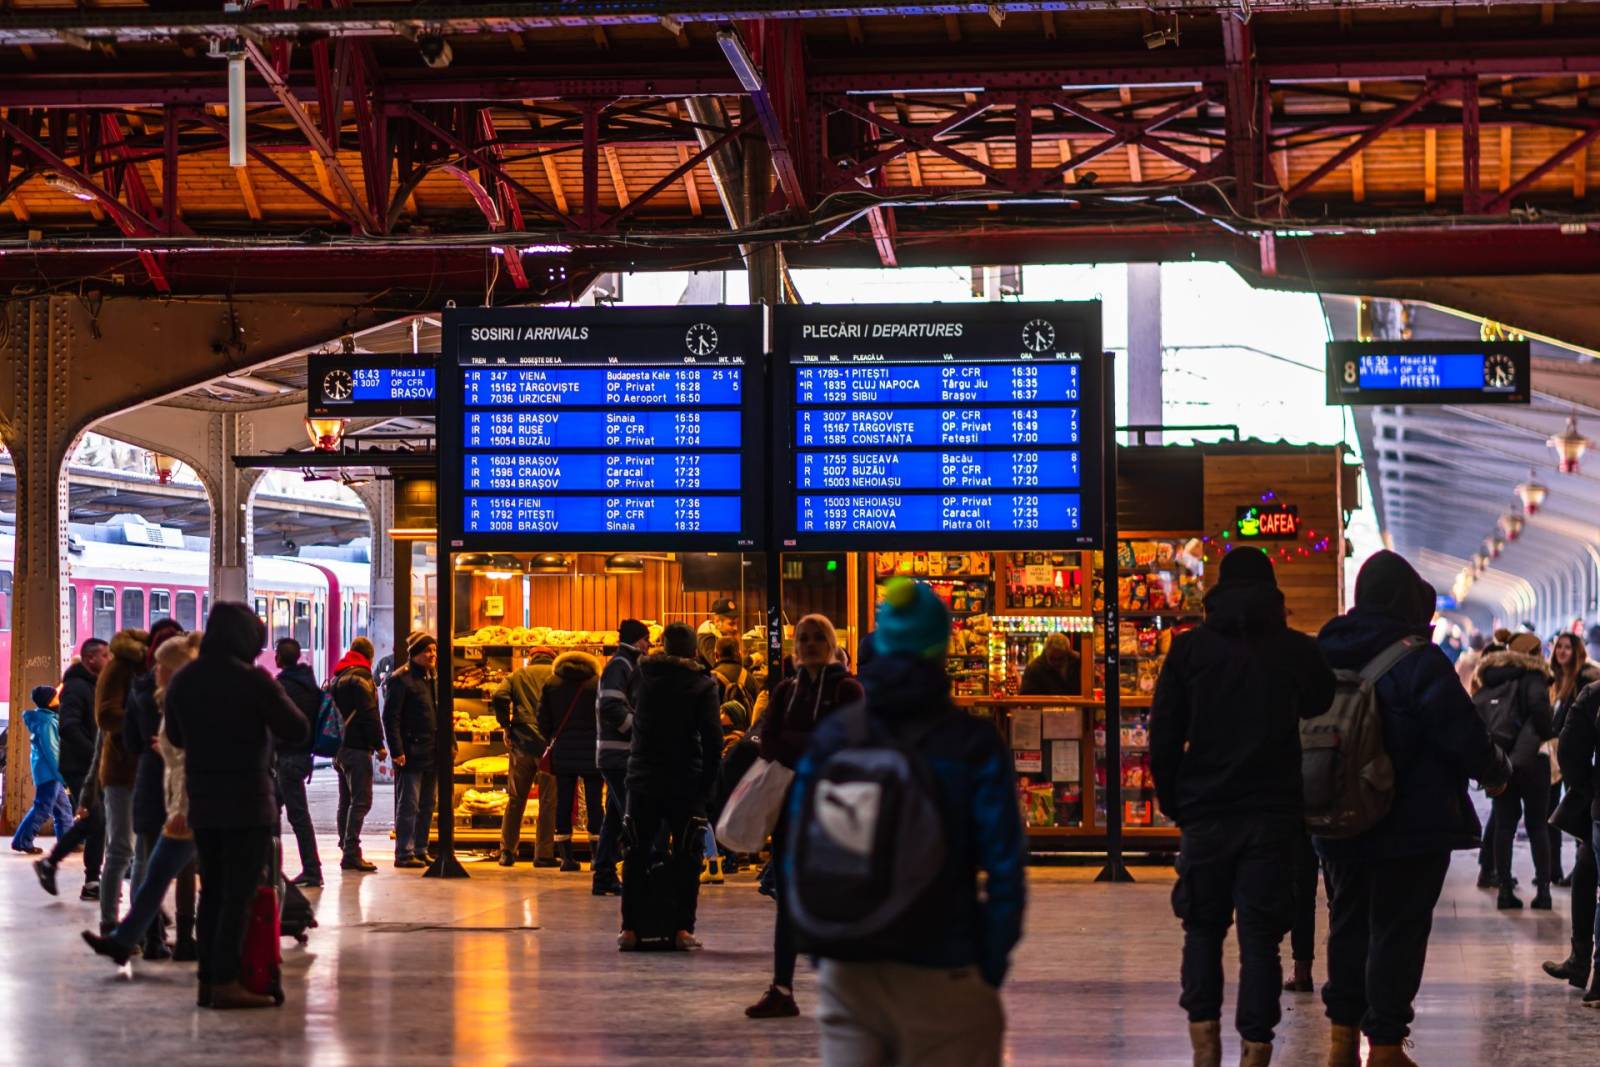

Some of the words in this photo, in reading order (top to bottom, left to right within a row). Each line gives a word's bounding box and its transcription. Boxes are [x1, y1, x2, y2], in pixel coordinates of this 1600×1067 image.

[472, 328, 514, 340] SOSIRI
[517, 328, 521, 340] /
[524, 327, 588, 340] ARRIVALS
[803, 322, 860, 338] PLECĂRI
[864, 324, 868, 337] /
[872, 323, 963, 337] DEPARTURES
[354, 369, 379, 379] 16:43
[491, 372, 507, 380] 347
[520, 372, 546, 380] VIENA
[607, 371, 650, 382] Budapesta
[652, 371, 670, 380] Kele
[676, 371, 700, 380] 16:08
[713, 370, 723, 380] 25
[728, 371, 738, 379] 14
[962, 368, 980, 377] CFR
[1012, 367, 1038, 376] 16:30
[1071, 366, 1076, 376] 8
[1344, 362, 1356, 383] 8
[491, 383, 516, 392] 15162
[626, 382, 655, 391] Privat
[675, 382, 700, 391] 16:28
[733, 382, 738, 390] 5
[824, 380, 846, 390] 1835
[852, 380, 876, 389] CLUJ
[880, 380, 920, 389] NAPOCA
[974, 379, 988, 388] Jiu
[1012, 378, 1038, 388] 16:35
[1072, 378, 1076, 386] 1
[491, 394, 513, 403] 7036
[519, 394, 561, 403] URZICENI
[607, 394, 620, 402] PO
[624, 394, 666, 404] Aeroport
[675, 393, 700, 402] 16:50
[824, 392, 846, 401] 1529
[852, 392, 877, 400] SIBIU
[1012, 390, 1037, 399] 16:37
[1066, 390, 1076, 398] 10
[491, 414, 513, 423] 1636
[607, 413, 635, 423] Sinaia
[675, 413, 700, 422] 16:58
[824, 412, 846, 421] 3007
[962, 410, 980, 420] CFR
[1012, 410, 1038, 419] 16:43
[1072, 410, 1076, 418] 7
[491, 425, 513, 434] 1094
[518, 425, 543, 434] RUSE
[626, 425, 644, 434] CFR
[675, 424, 700, 434] 17:00
[824, 423, 850, 432] 15167
[962, 422, 991, 431] Privat
[1012, 421, 1038, 431] 16:49
[1071, 421, 1076, 430] 5
[490, 436, 516, 446] 15054
[626, 436, 654, 445] Privat
[675, 436, 700, 445] 17:04
[824, 435, 846, 444] 1585
[1012, 433, 1038, 442] 17:00
[1071, 432, 1077, 442] 9
[490, 456, 516, 465] 16034
[626, 456, 654, 465] Privat
[675, 456, 700, 464] 17:17
[824, 454, 846, 464] 1755
[853, 454, 898, 464] SUCEAVA
[1012, 453, 1038, 462] 17:00
[1072, 453, 1077, 462] 8
[491, 468, 513, 476] 1596
[518, 468, 561, 476] CRAIOVA
[606, 467, 643, 476] Caracal
[675, 467, 700, 476] 17:23
[824, 466, 846, 475] 5007
[962, 465, 981, 474] CFR
[1012, 464, 1038, 474] 17:07
[490, 479, 516, 488] 15934
[626, 479, 654, 488] Privat
[675, 478, 700, 488] 17:29
[824, 478, 850, 486] 15003
[962, 476, 991, 486] Privat
[1013, 476, 1038, 485] 17:20
[490, 499, 516, 508] 15164
[518, 499, 540, 508] FIENI
[626, 499, 654, 508] Privat
[675, 498, 700, 508] 17:36
[824, 498, 850, 506] 15003
[962, 497, 991, 506] Privat
[1013, 496, 1038, 506] 17:20
[491, 510, 512, 519] 1792
[626, 510, 644, 519] CFR
[675, 510, 700, 519] 17:55
[824, 509, 847, 518] 1593
[853, 509, 896, 518] CRAIOVA
[943, 508, 980, 517] Caracal
[1013, 508, 1038, 517] 17:25
[1067, 508, 1077, 516] 12
[490, 522, 512, 530] 3008
[606, 521, 635, 530] Sinaia
[675, 521, 700, 530] 18:32
[824, 520, 846, 529] 1897
[853, 520, 896, 529] CRAIOVA
[943, 520, 972, 529] Piatra
[976, 520, 990, 528] Olt
[1013, 519, 1038, 528] 17:30
[1072, 519, 1077, 528] 5
[1259, 514, 1295, 532] CAFEA
